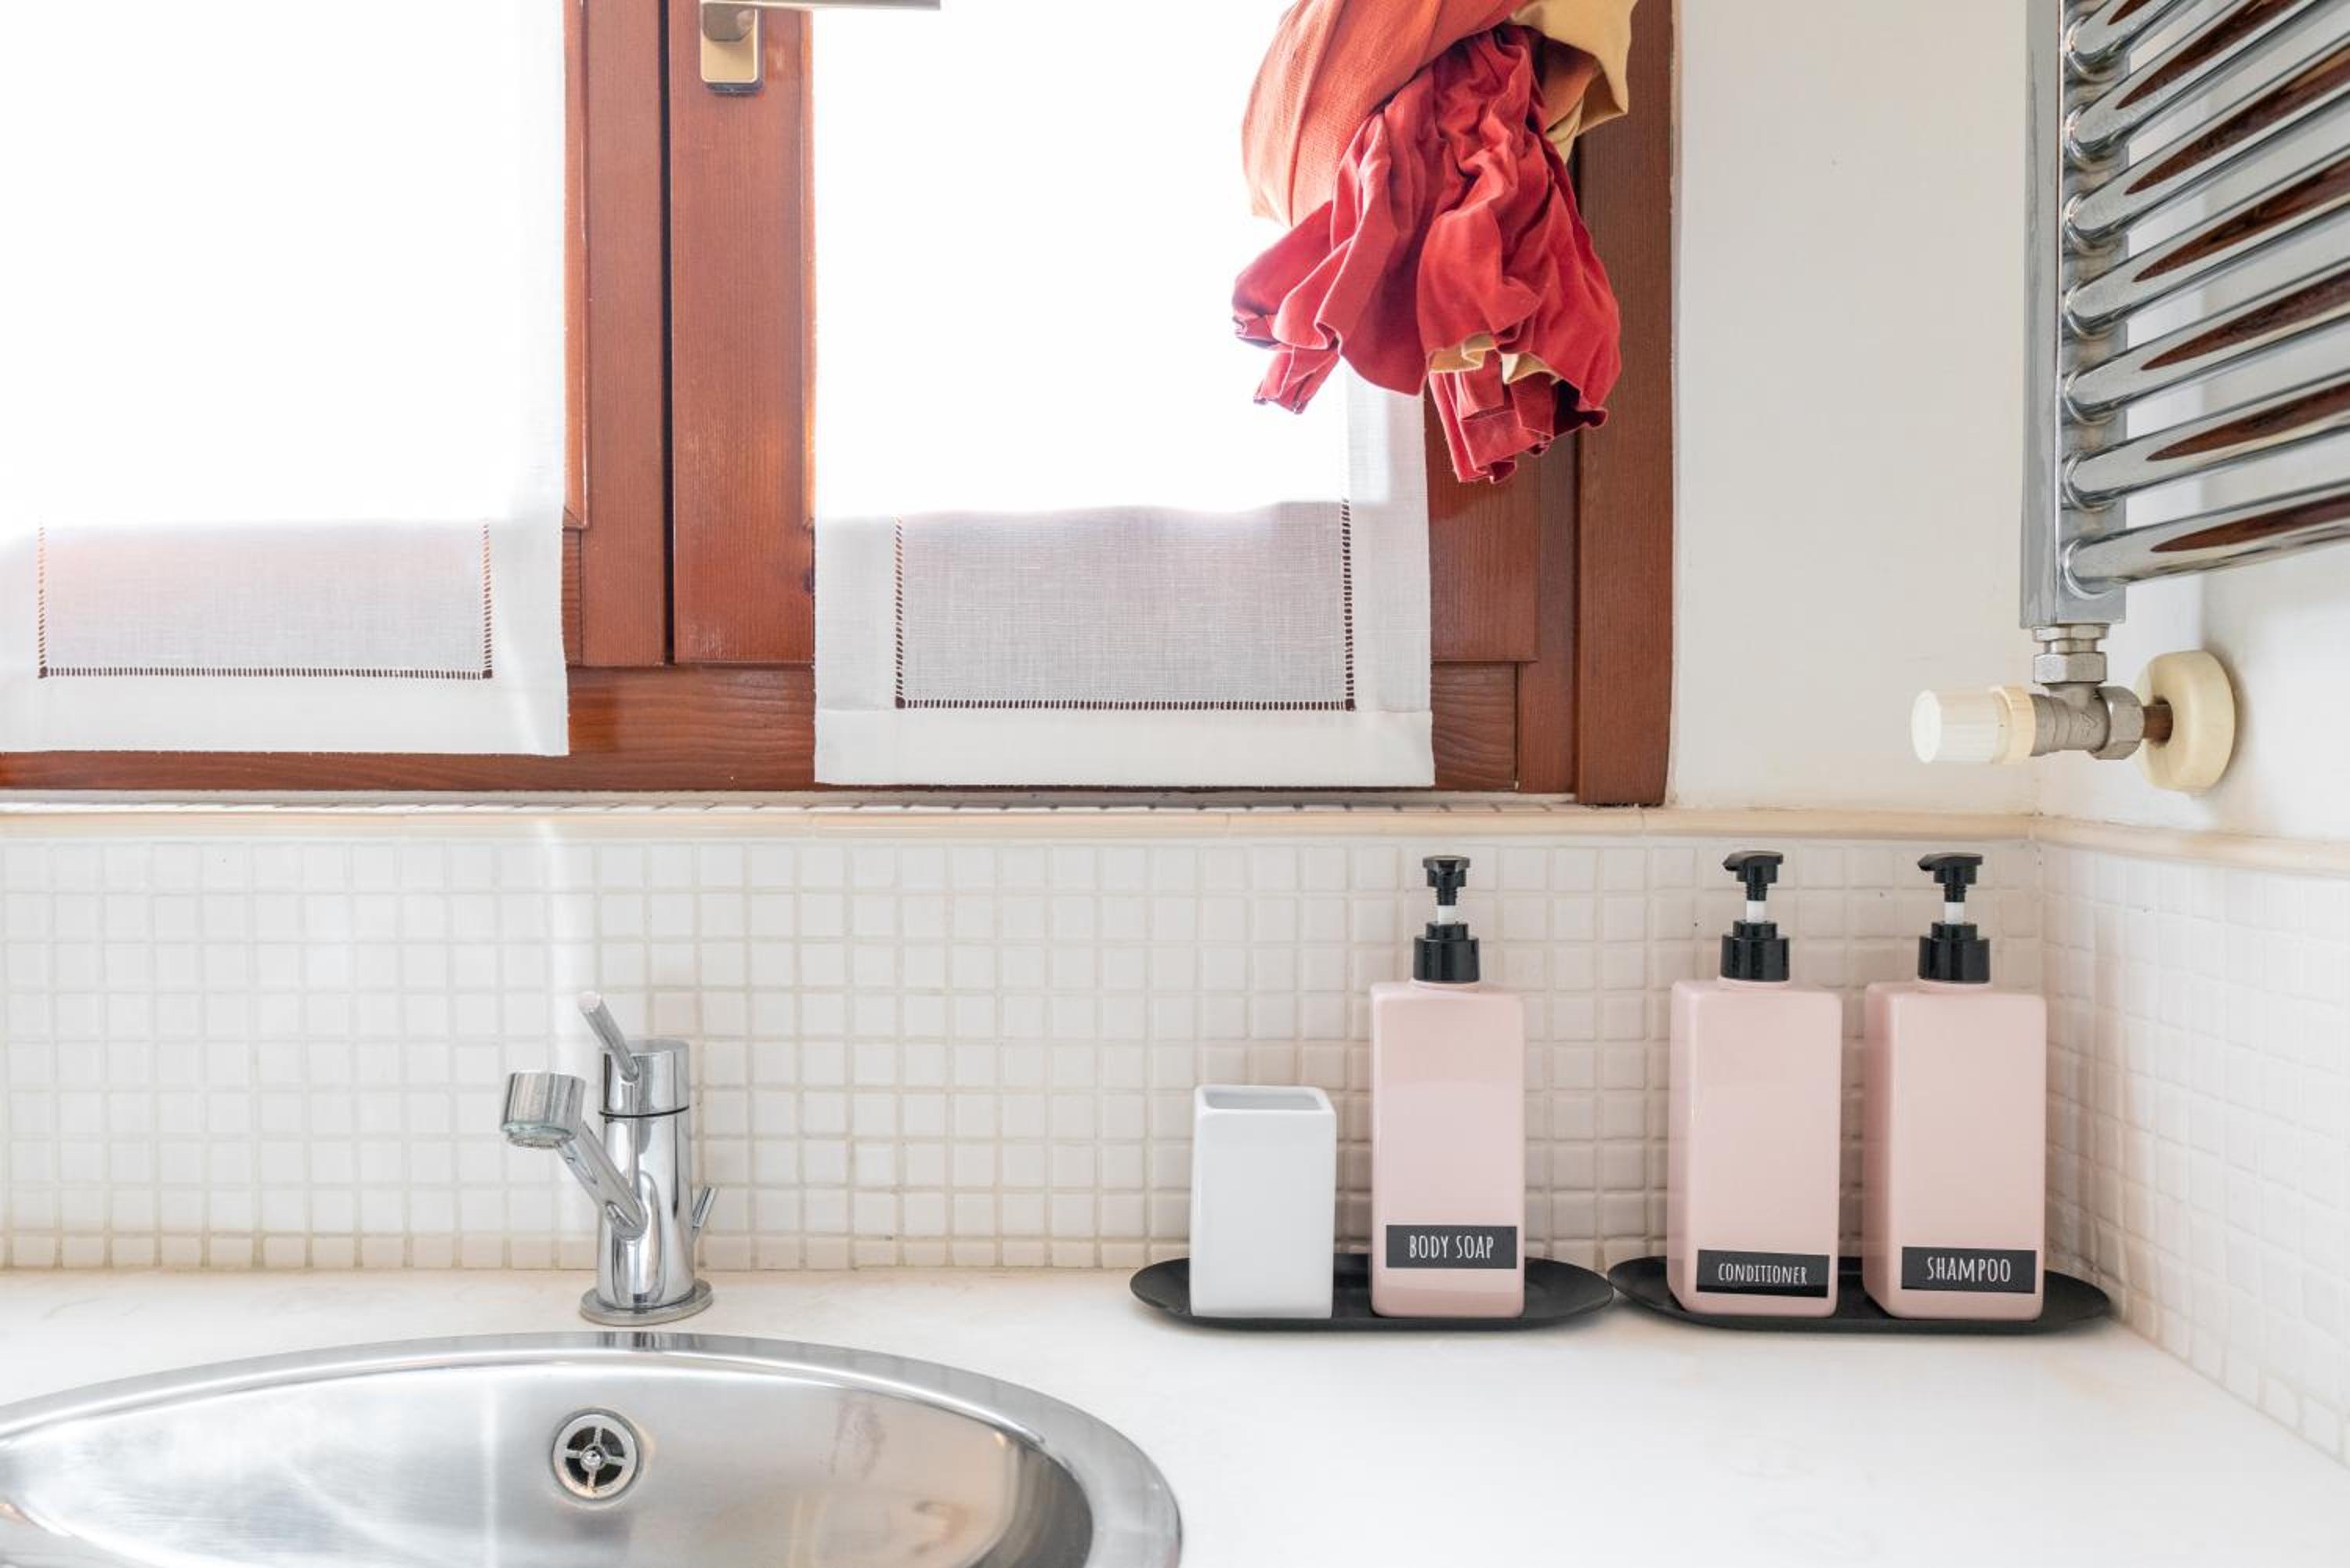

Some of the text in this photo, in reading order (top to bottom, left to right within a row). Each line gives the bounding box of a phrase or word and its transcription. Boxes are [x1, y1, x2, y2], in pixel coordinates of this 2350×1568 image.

[1409, 1235, 1494, 1259] BODY SOAP
[1718, 1263, 1808, 1285] CONDITIONER
[1927, 1256, 2012, 1283] SHAMPOO
